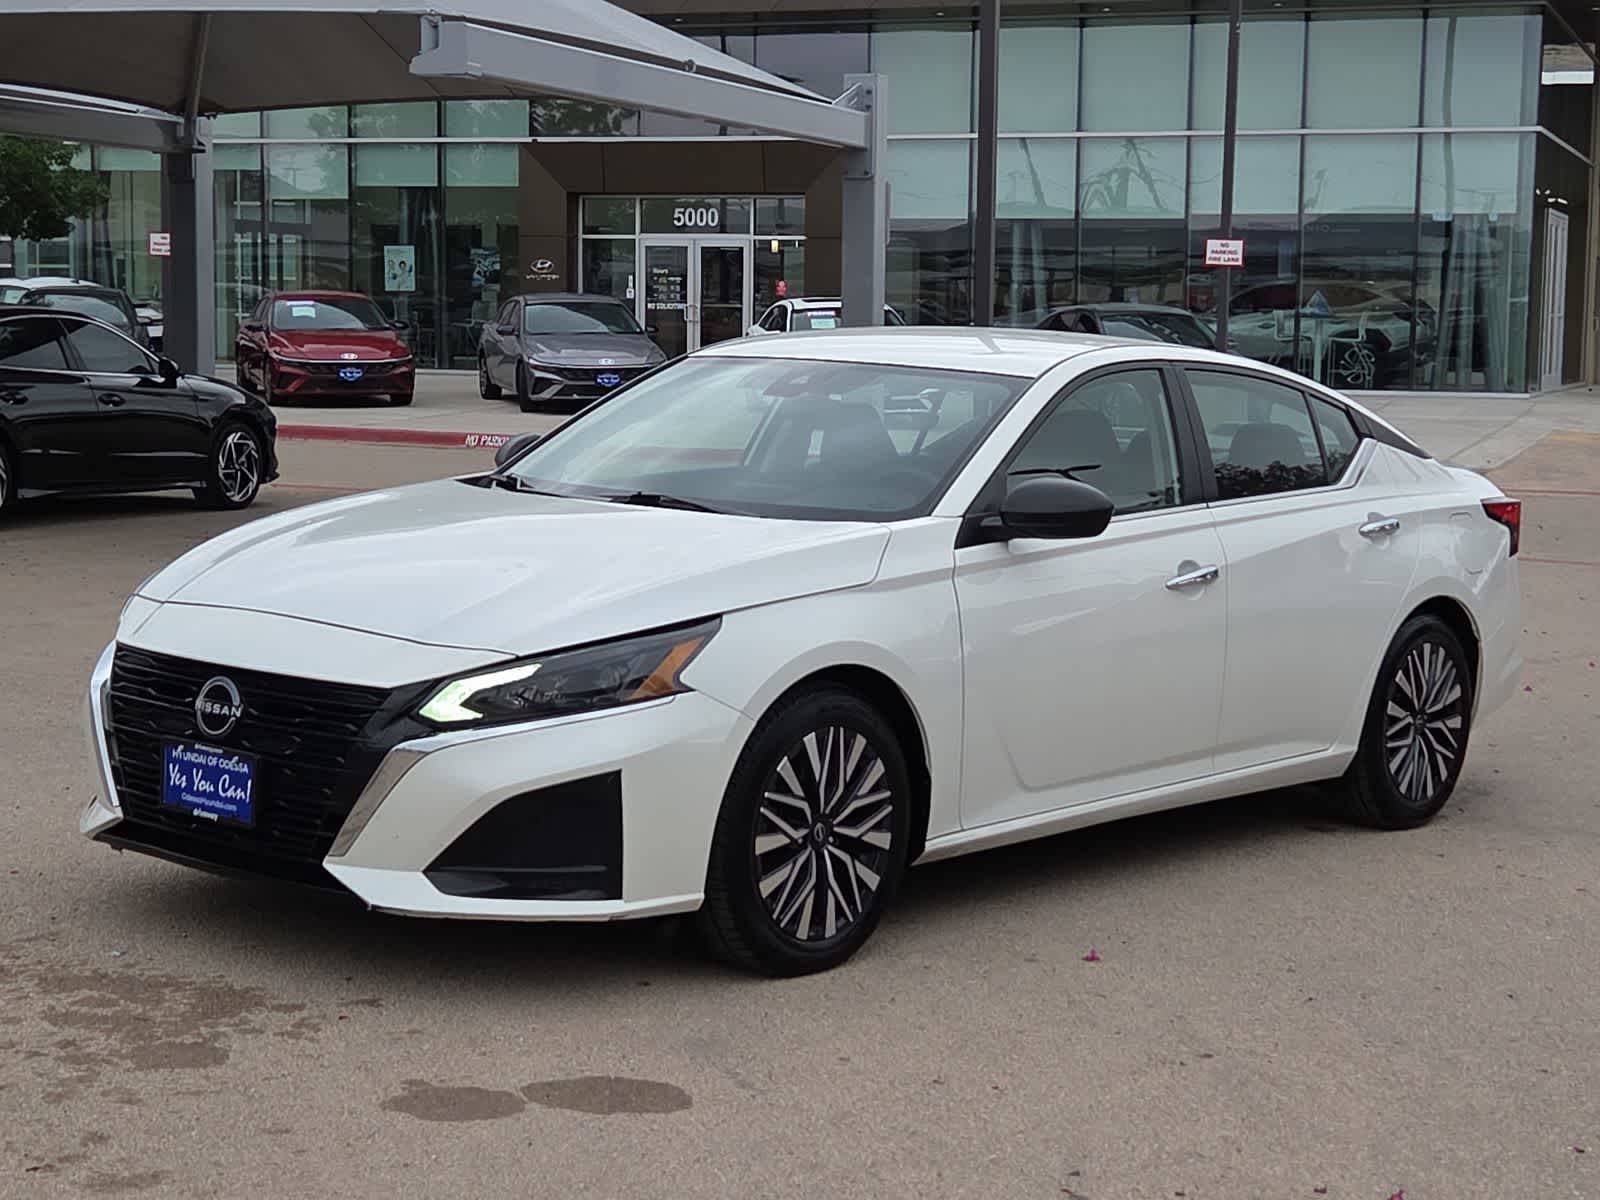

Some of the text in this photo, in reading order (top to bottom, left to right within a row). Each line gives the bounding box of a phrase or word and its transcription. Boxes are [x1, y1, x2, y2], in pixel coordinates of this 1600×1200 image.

[673, 207, 719, 227] 5000
[465, 434, 509, 446] NO PARK
[195, 700, 242, 718] NISSAN
[207, 756, 218, 767] OF
[169, 763, 252, 803] Yes You Can!
